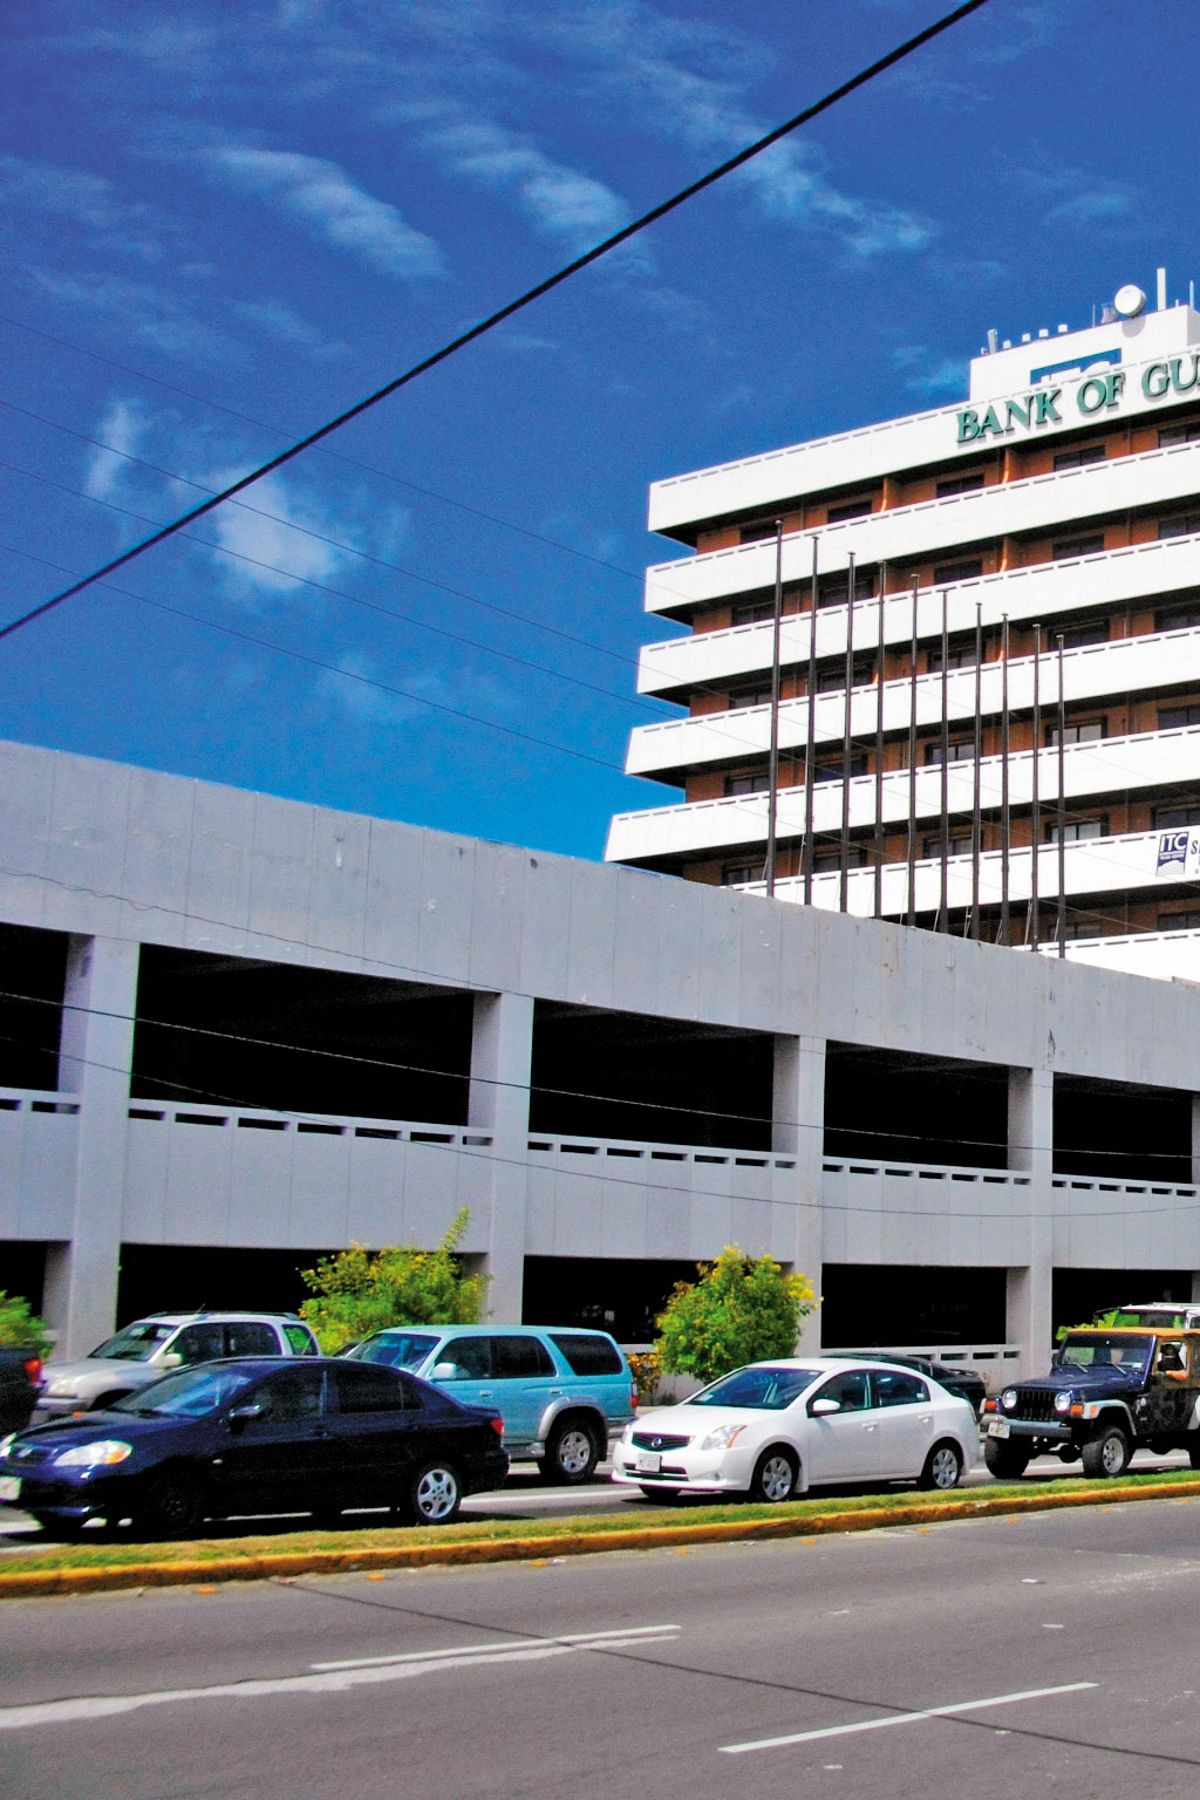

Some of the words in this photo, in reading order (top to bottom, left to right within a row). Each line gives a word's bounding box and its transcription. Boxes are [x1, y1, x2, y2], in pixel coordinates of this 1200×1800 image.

[956, 389, 1063, 444] BANK
[1076, 373, 1126, 414] OF
[1160, 832, 1188, 852] ITC
